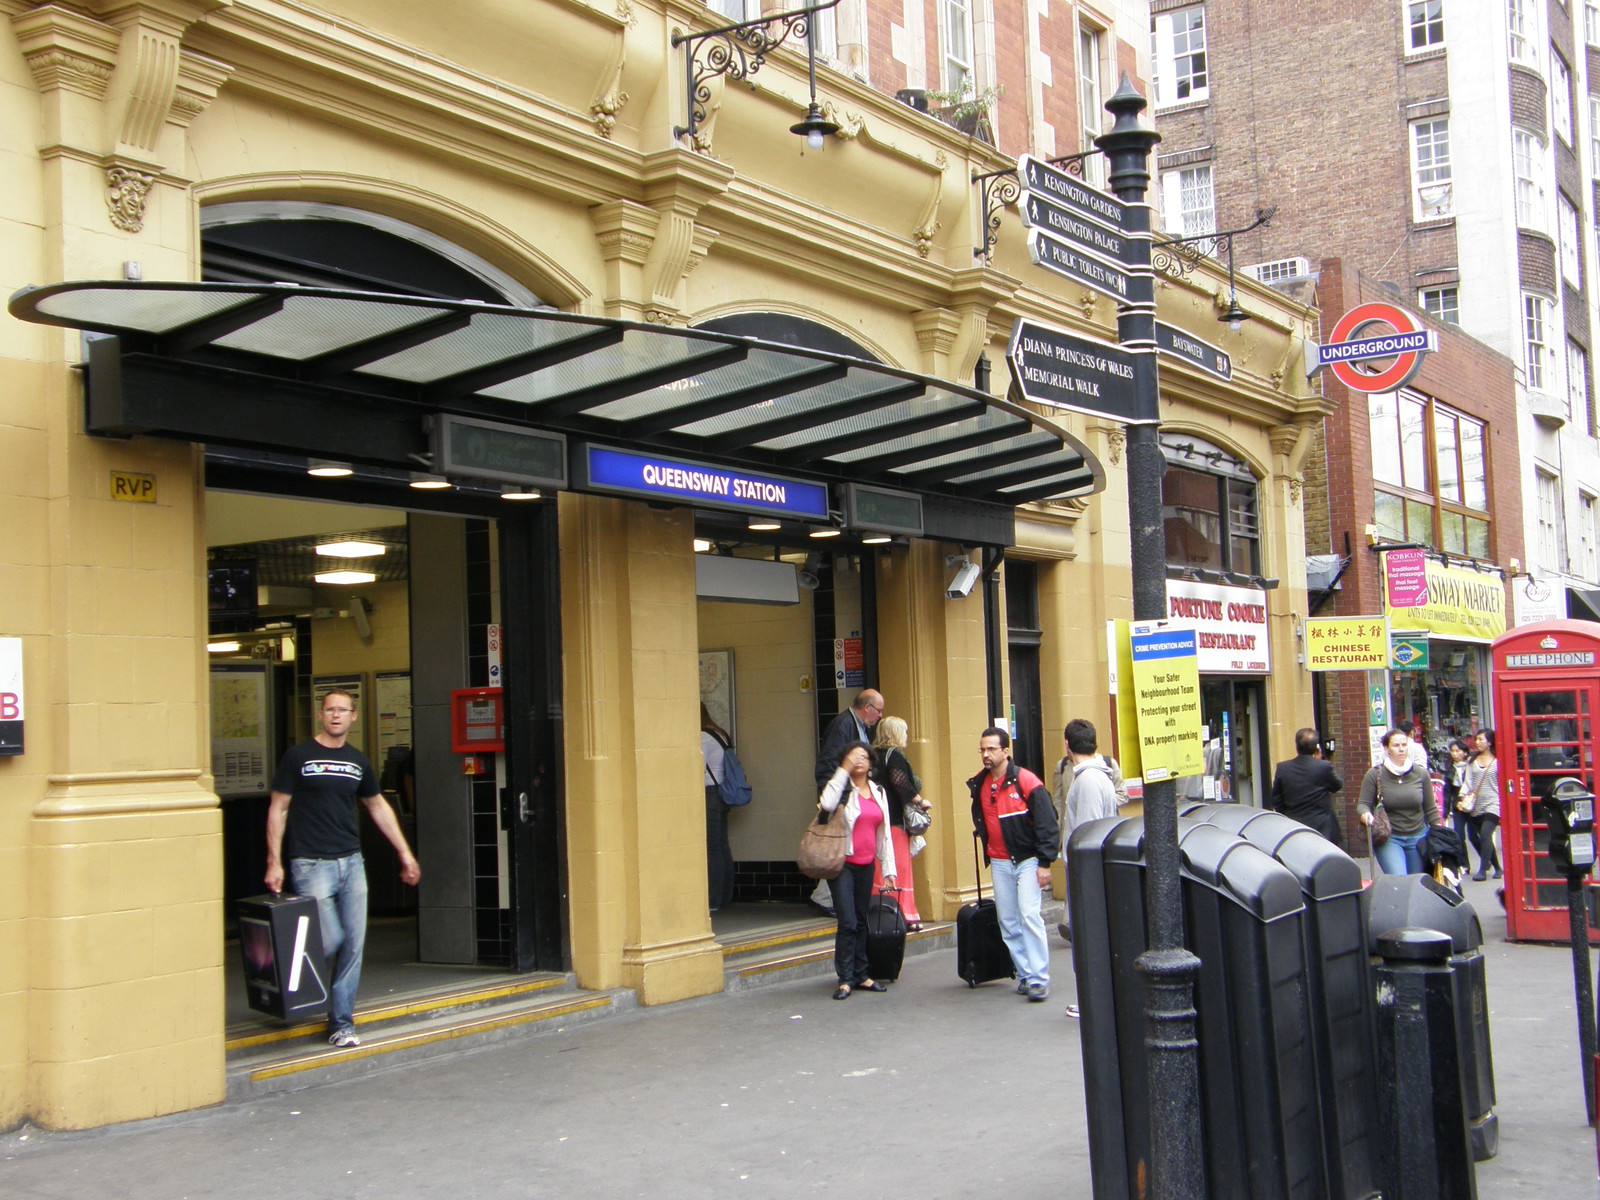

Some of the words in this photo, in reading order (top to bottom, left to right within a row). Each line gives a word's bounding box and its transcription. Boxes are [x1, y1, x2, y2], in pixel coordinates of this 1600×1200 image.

[1044, 173, 1089, 206] KENSINGTON
[1090, 196, 1121, 221] GARDENS
[1048, 210, 1093, 242] KENSINGTON
[1094, 231, 1120, 254] PALACE
[1052, 246, 1077, 269] PUBLIC
[1078, 258, 1105, 282] TOILETS
[1172, 334, 1204, 360] BAYSWATER
[1322, 335, 1425, 359] UNDERGROUND
[1024, 337, 1053, 357] DIANA
[1055, 346, 1096, 369] PRINCESS
[1096, 358, 1107, 372] OF
[1107, 361, 1134, 380] WALES
[1024, 366, 1075, 391] MEMORIAL
[1075, 379, 1100, 397] WALK
[115, 476, 153, 497] RVP
[642, 464, 729, 496] QUEENSWAY
[733, 478, 786, 504] STATION
[1387, 552, 1424, 560] KOBKUN
[1426, 573, 1460, 608] NSWAY
[1462, 580, 1500, 614] MARKET
[1170, 596, 1223, 621] FORTUNE
[1228, 602, 1265, 624] COOKIE
[1135, 644, 1150, 653] CRIME
[1149, 642, 1178, 651] PREVENTION
[1177, 640, 1194, 649] ADVICE
[1199, 632, 1256, 651] RESTAURANT
[1324, 643, 1371, 653] CHINESE
[1312, 654, 1384, 664] RESTAURANT
[1510, 652, 1591, 666] TELEPHONE
[1153, 675, 1166, 684] Your
[1166, 673, 1180, 683] Safer
[1140, 686, 1180, 699] Neighbourhood
[1180, 685, 1195, 694] Team
[1141, 706, 1169, 717] Protecting
[1169, 705, 1181, 714] your
[1181, 702, 1197, 712] street
[1164, 718, 1176, 727] with
[1144, 736, 1155, 746] DNA
[1155, 733, 1177, 746] property
[1177, 731, 1198, 741] marking
